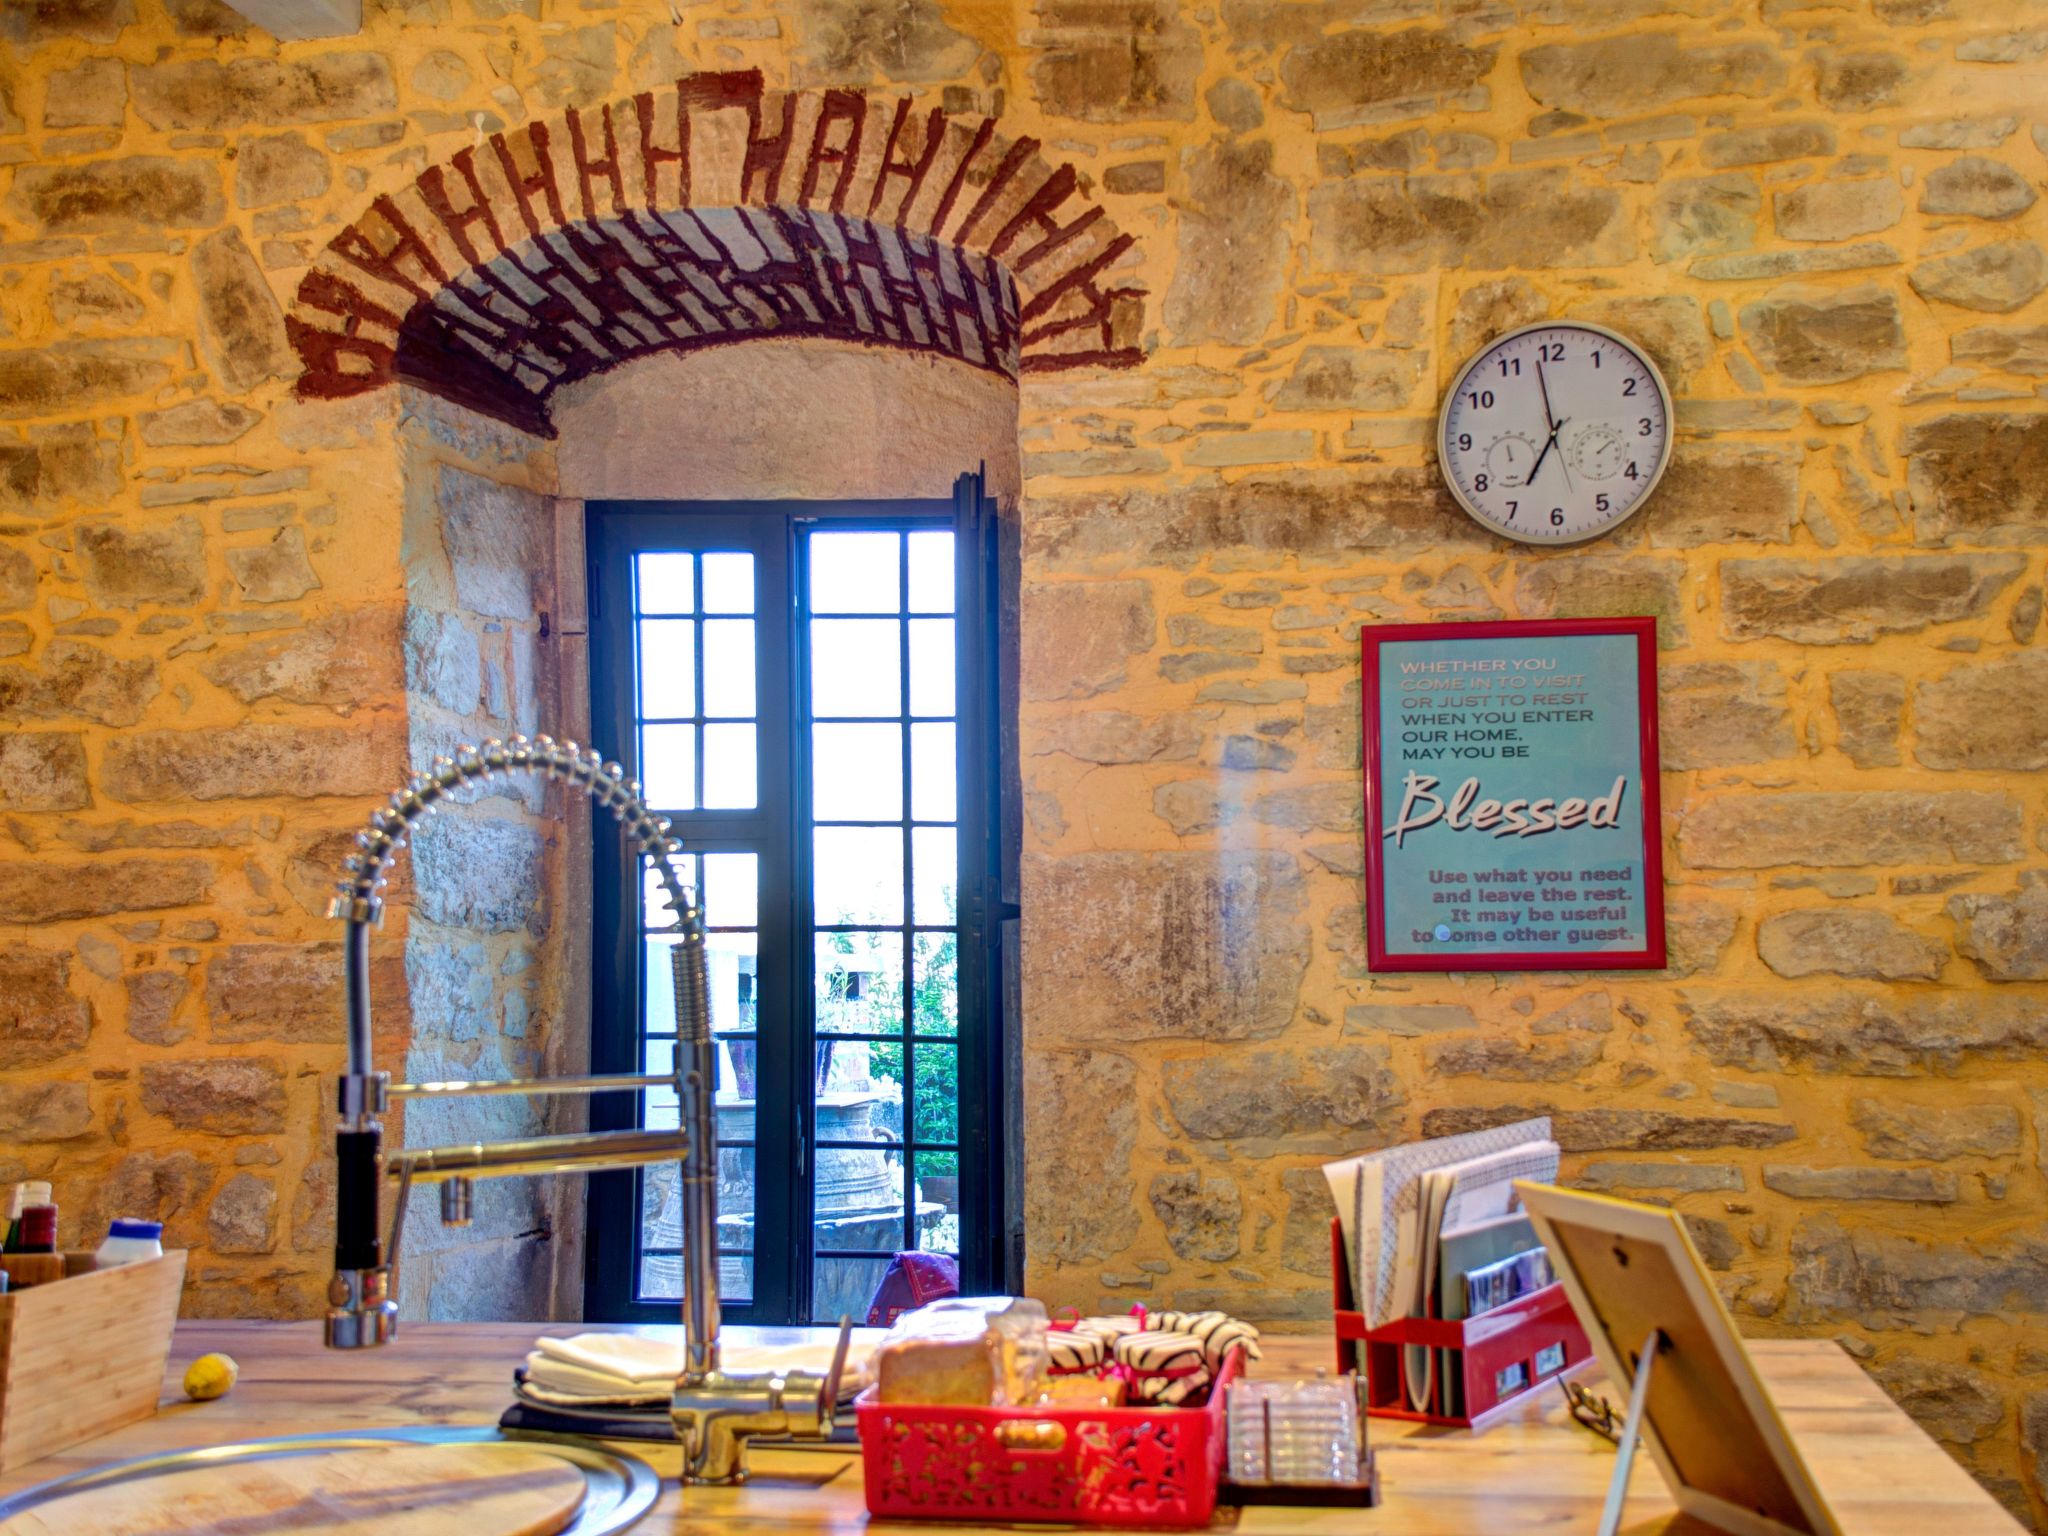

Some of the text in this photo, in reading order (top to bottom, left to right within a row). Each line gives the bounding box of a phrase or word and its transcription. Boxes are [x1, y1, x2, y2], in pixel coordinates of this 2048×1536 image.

[1538, 342, 1566, 363] 12
[1590, 351, 1601, 369] 1
[1497, 358, 1521, 377] 11
[1622, 378, 1637, 397] 2
[1468, 390, 1495, 410] 10
[1638, 417, 1652, 437] 3
[1458, 433, 1472, 452] 9
[1623, 461, 1639, 481] 4
[1474, 473, 1488, 493] 8
[1505, 501, 1518, 520] 7
[1595, 493, 1609, 512] 5
[1550, 507, 1564, 526] 6
[1400, 657, 1558, 675] WHETHER YOU
[1400, 673, 1586, 693] COME IN TO VISIT
[1401, 692, 1590, 710] OR JUST TO REST
[1401, 709, 1595, 726] WHEN YOU ENTER
[1401, 728, 1524, 744] OUR HOME,
[1402, 745, 1530, 761] MAY YOU BE
[1382, 769, 1628, 850] Blessed
[1428, 866, 1633, 885] Use what you need
[1432, 886, 1633, 903] and leave the rest.
[1450, 905, 1628, 925] It may be useful
[1411, 928, 1434, 943] to
[1503, 927, 1561, 943] other
[1567, 926, 1635, 945] guest.
